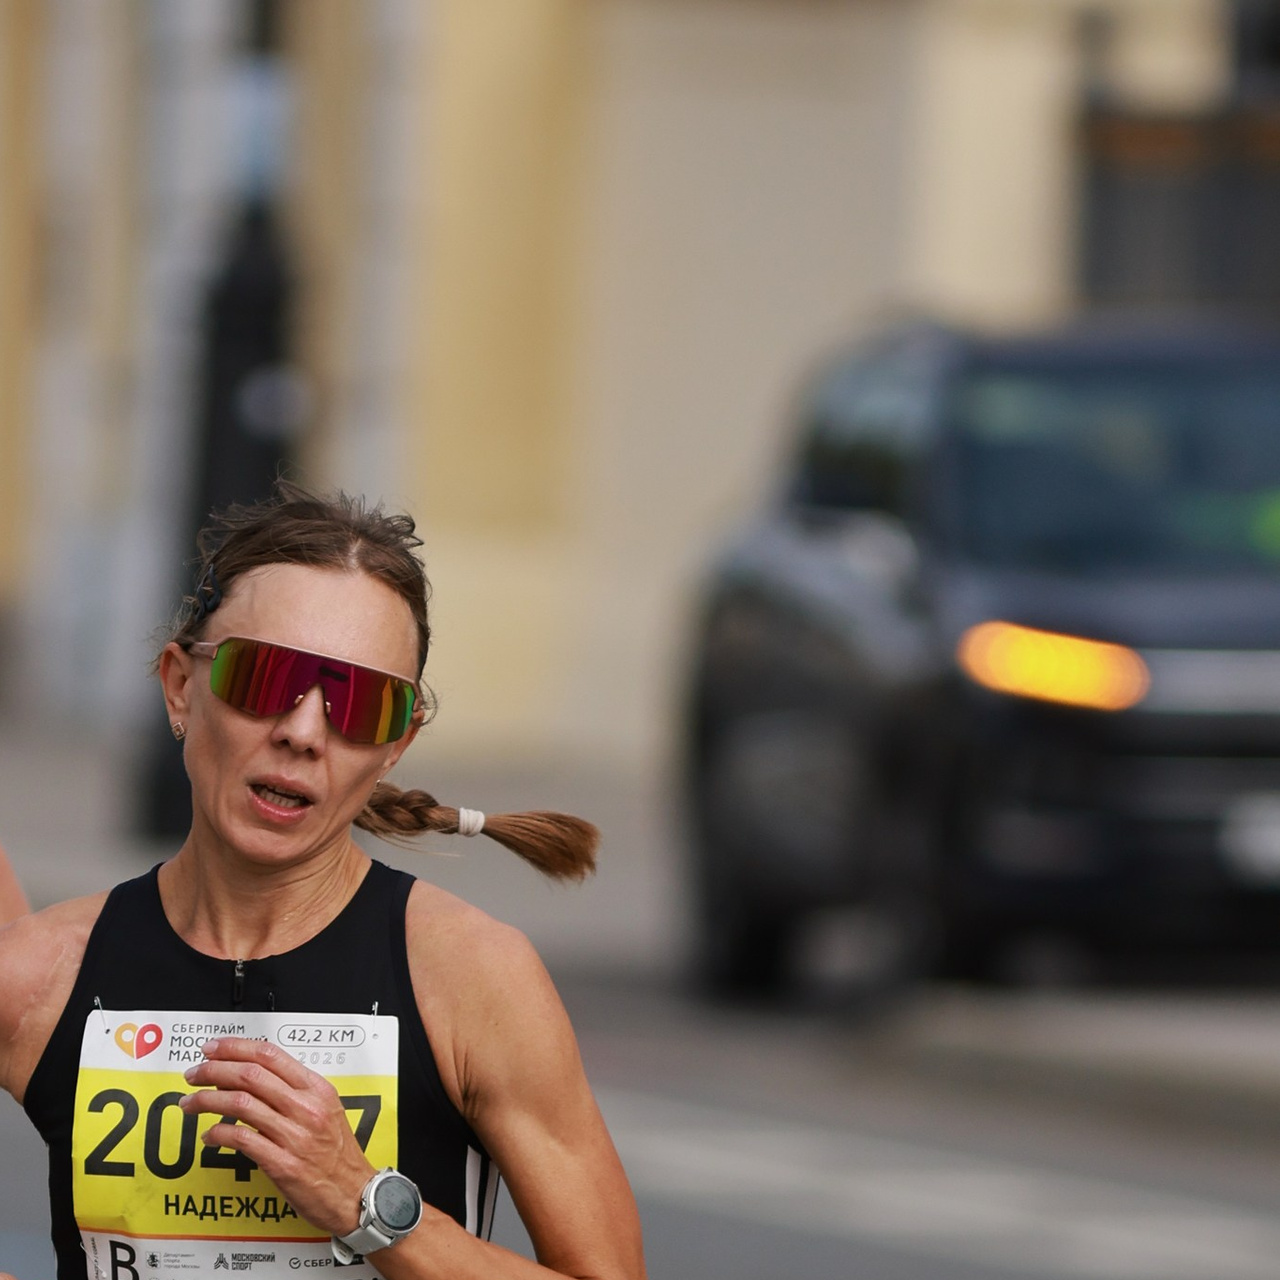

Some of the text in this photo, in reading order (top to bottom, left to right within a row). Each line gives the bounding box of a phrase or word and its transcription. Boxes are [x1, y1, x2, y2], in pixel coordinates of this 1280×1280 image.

[171, 1023, 245, 1034] СБЕРПРАЙМ
[287, 1029, 355, 1043] 42,2 КМ
[297, 1051, 347, 1065] 2026
[84, 1088, 382, 1183] 2047
[164, 1194, 299, 1223] НАДЕЖДА
[231, 1252, 275, 1263] МОСКОВСКИЙ
[303, 1258, 332, 1268] СБЕР
[231, 1262, 252, 1271] СПОРТ
